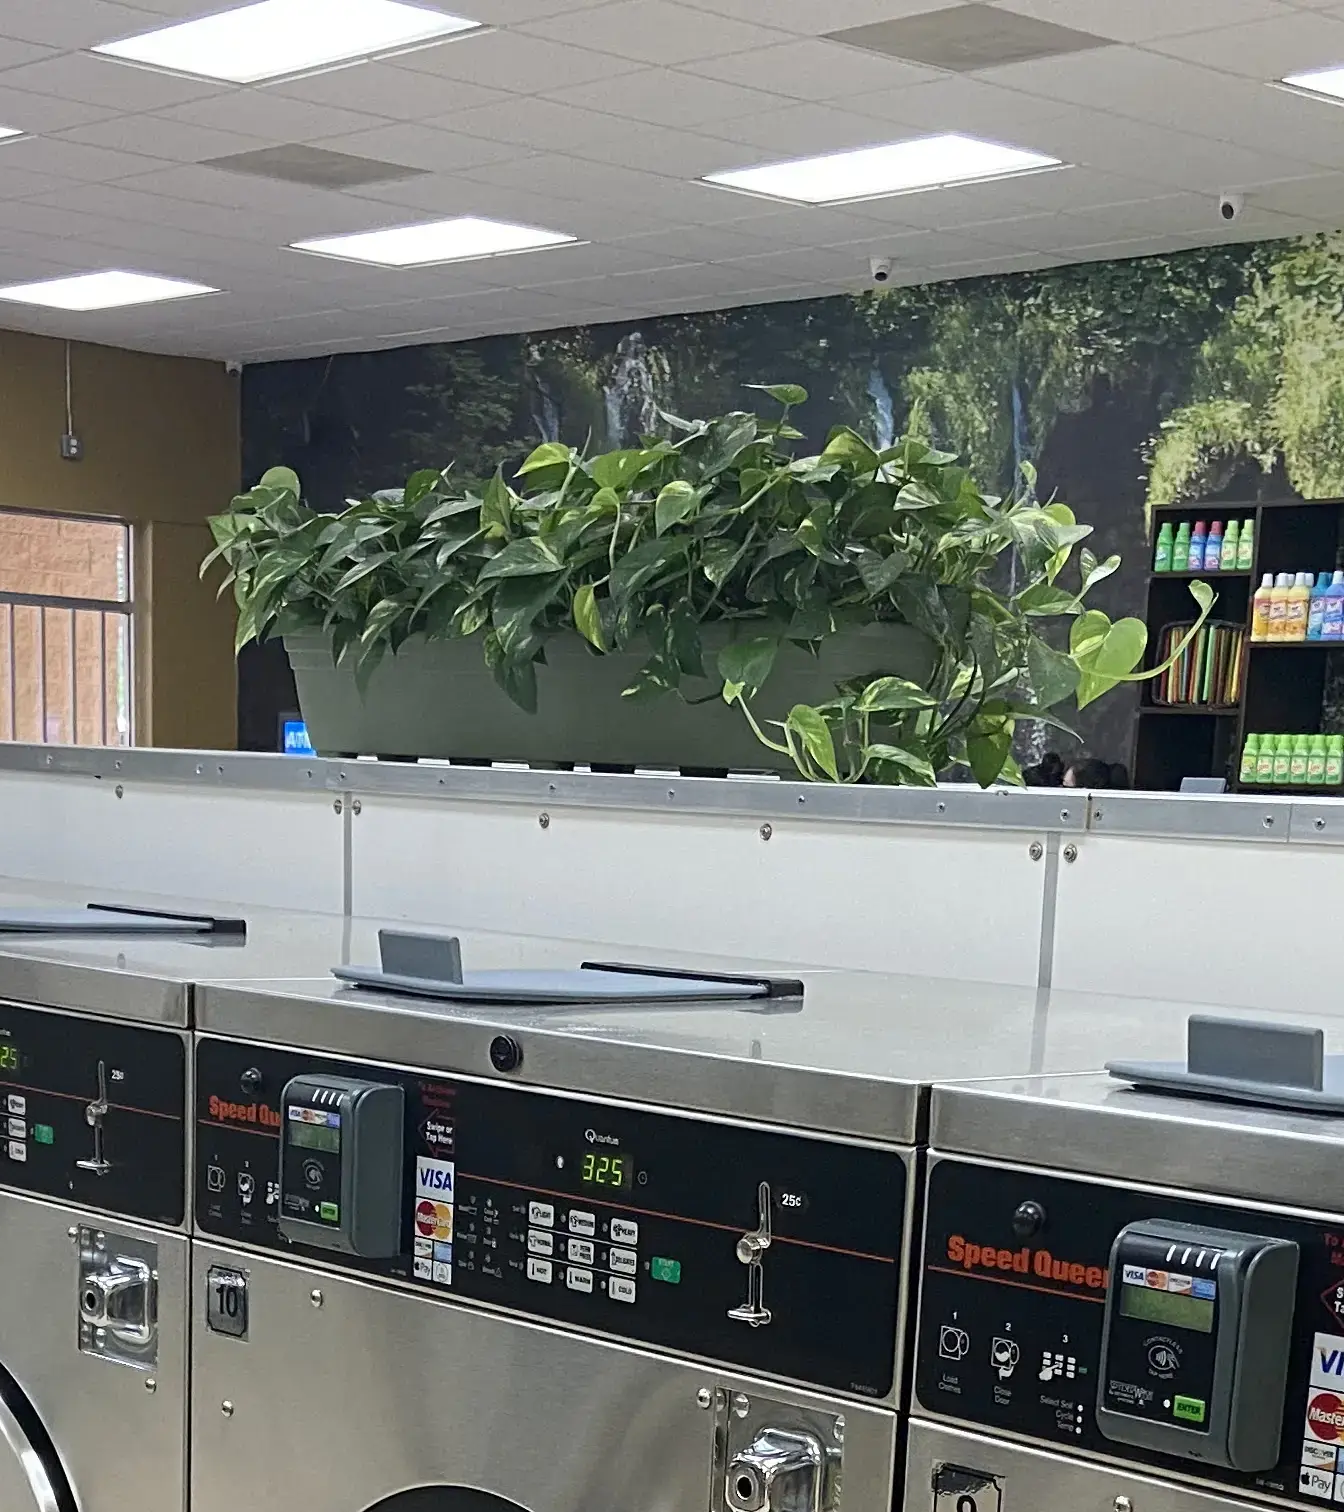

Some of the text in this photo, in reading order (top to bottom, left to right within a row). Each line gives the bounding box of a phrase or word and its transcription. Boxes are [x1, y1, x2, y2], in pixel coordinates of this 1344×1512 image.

[209, 1095, 256, 1122] Speed
[420, 1167, 452, 1192] VISA
[582, 1154, 623, 1186] 325
[1324, 1232, 1338, 1246] To
[947, 1235, 1030, 1274] Speed
[1125, 1269, 1144, 1281] VISA
[216, 1283, 238, 1318] 10
[952, 1311, 1069, 1343] 1 2 3
[1176, 1403, 1201, 1416] ENTER
[1311, 1474, 1332, 1494] Pay
